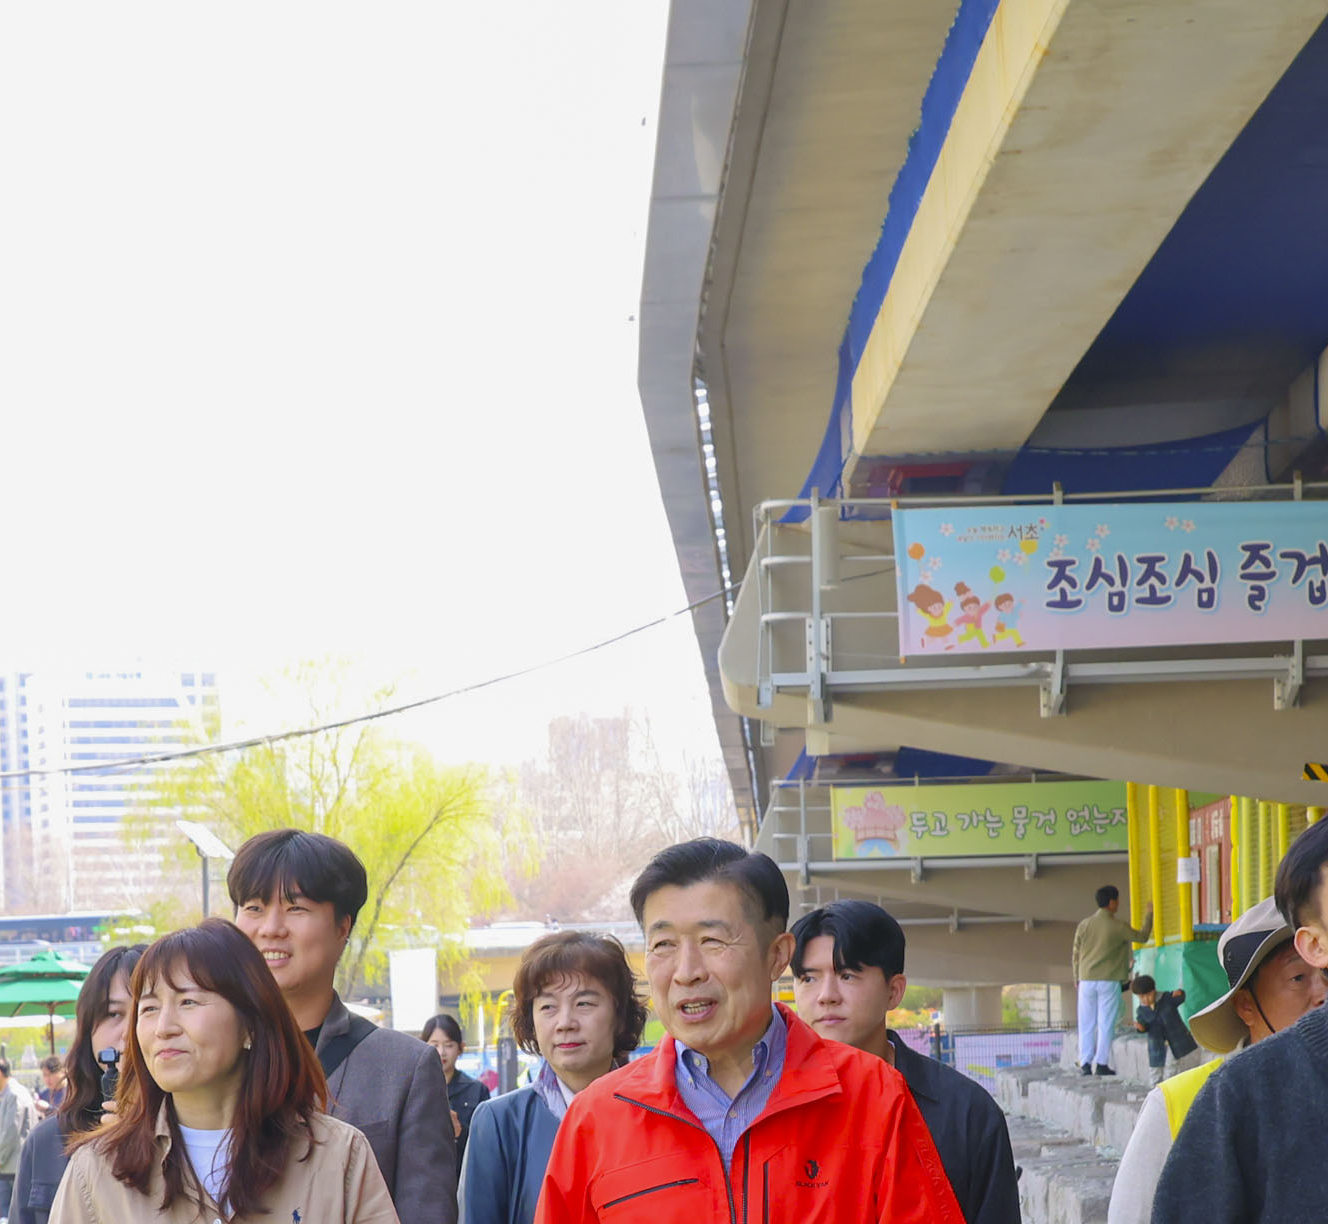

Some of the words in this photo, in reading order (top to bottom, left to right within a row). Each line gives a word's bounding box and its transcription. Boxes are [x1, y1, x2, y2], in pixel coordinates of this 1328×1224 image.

[1008, 523, 1039, 541] 서초
[1045, 550, 1219, 613] 조심조심
[910, 812, 949, 839] 두고
[957, 809, 1003, 838] 가는
[1013, 806, 1057, 839] 물건
